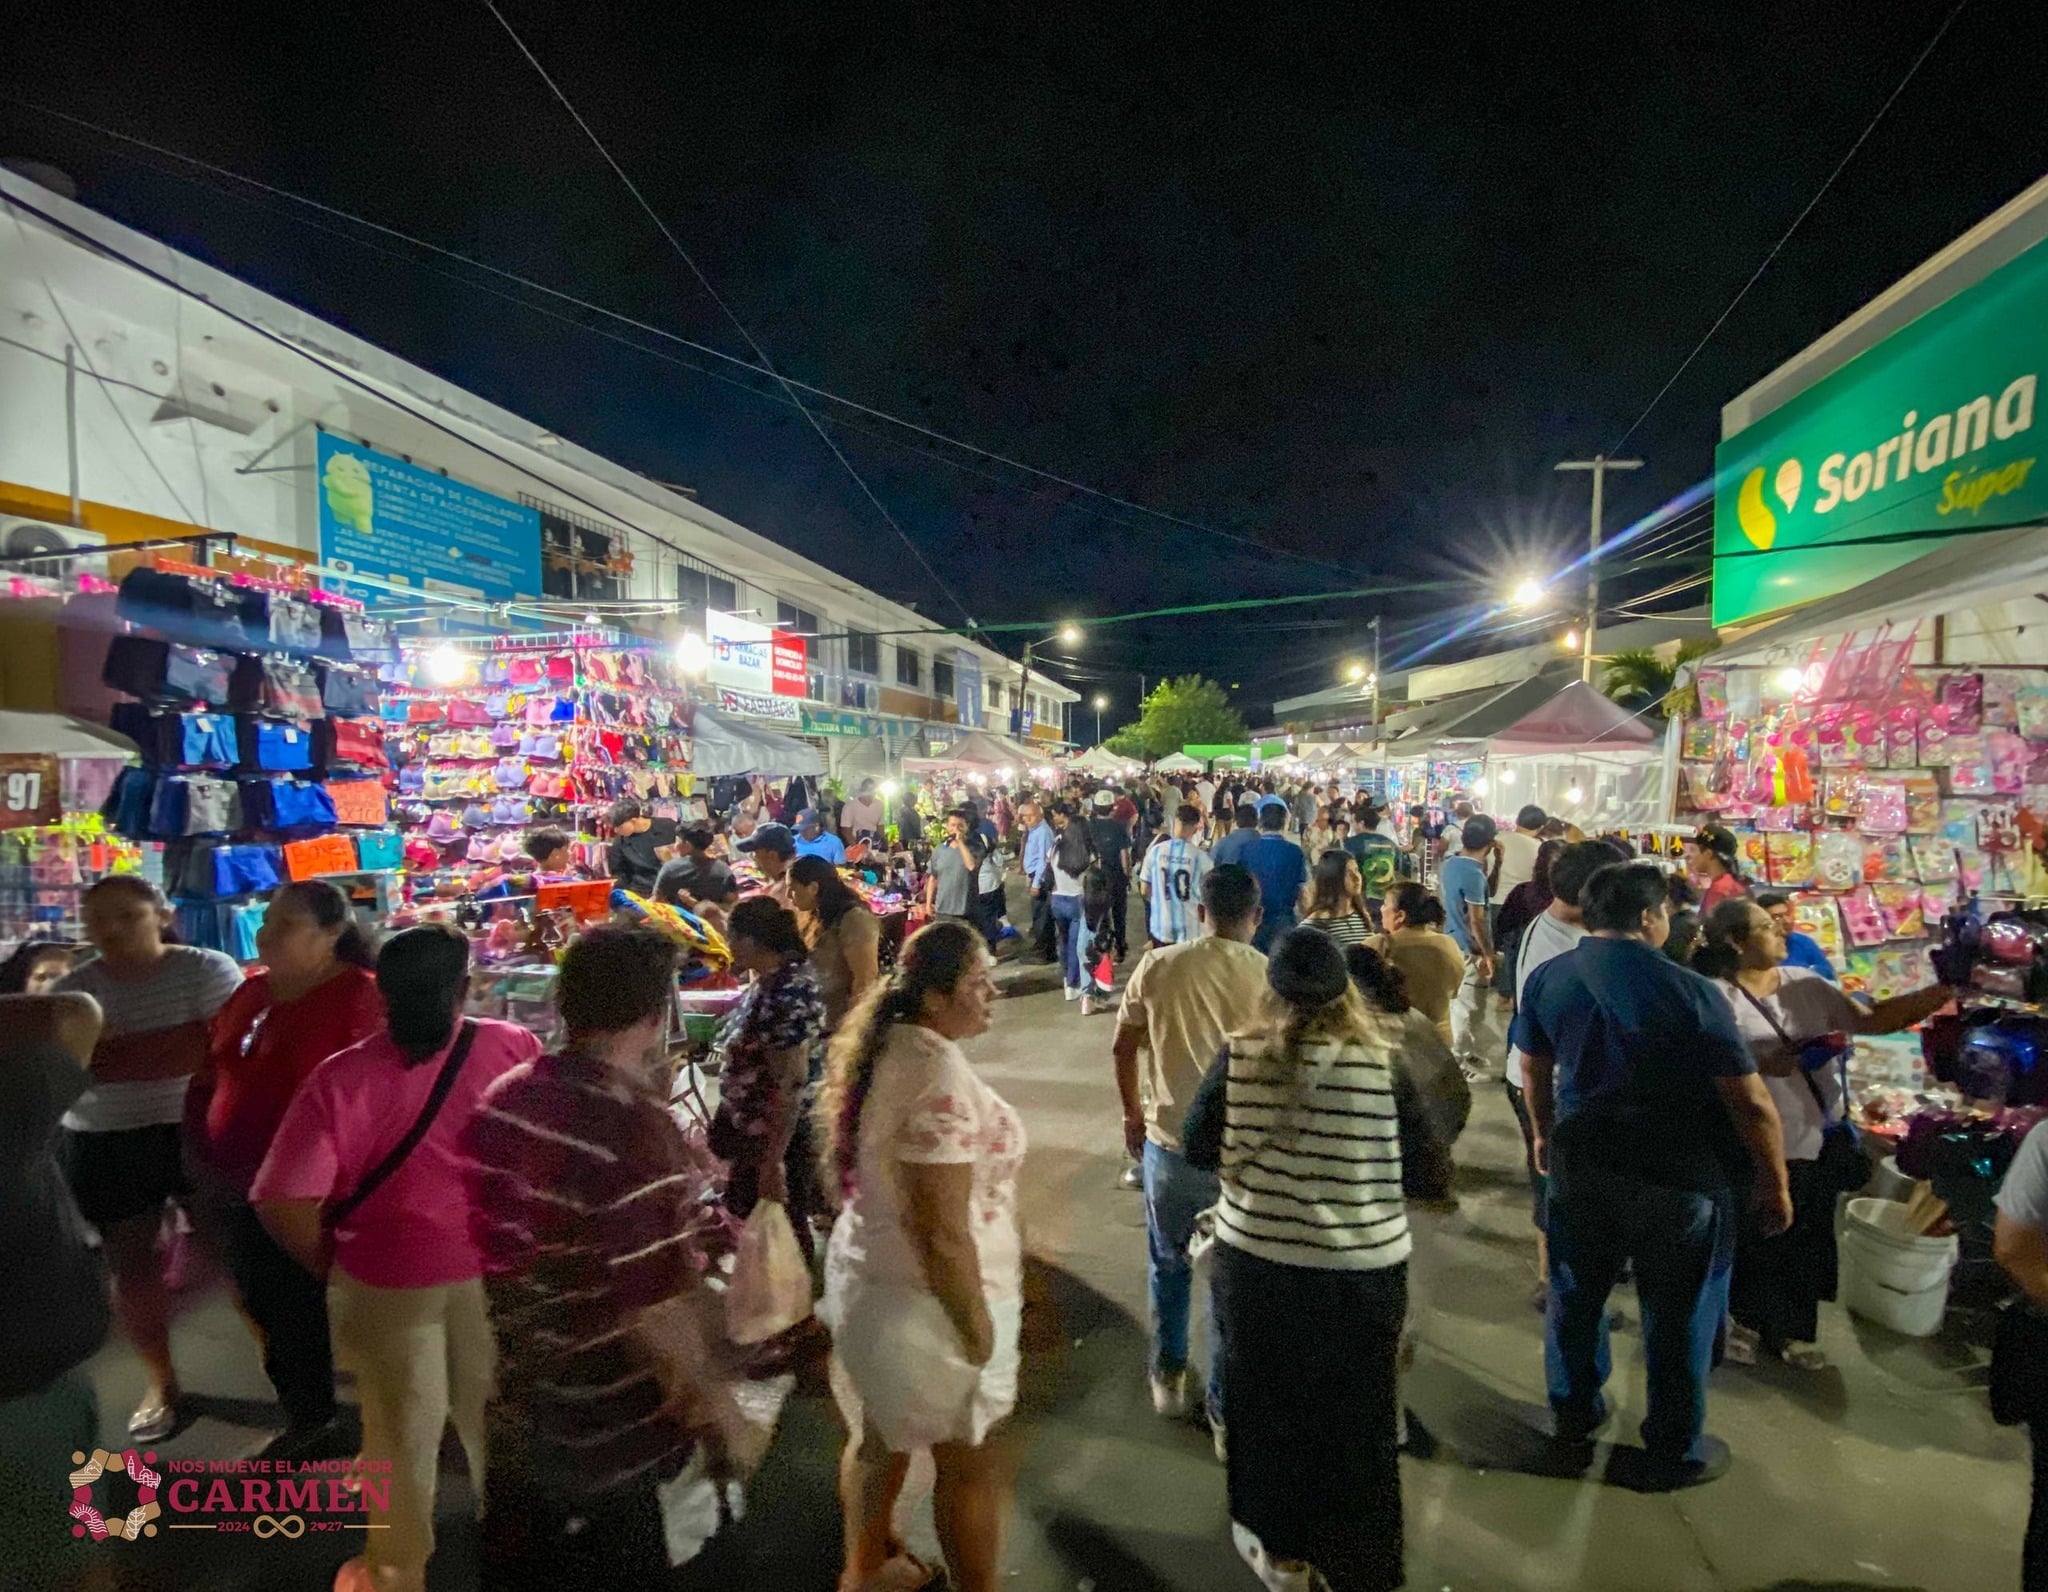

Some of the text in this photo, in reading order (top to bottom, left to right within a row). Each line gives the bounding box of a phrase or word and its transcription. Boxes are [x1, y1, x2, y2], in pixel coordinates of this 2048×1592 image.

[1814, 374, 2038, 514] Soriana
[376, 479, 417, 499] VENTA
[420, 492, 435, 506] DE
[448, 489, 462, 501] DE
[1936, 457, 2037, 517] Súper
[738, 653, 762, 670] BAZAR
[1160, 867, 1191, 902] 10
